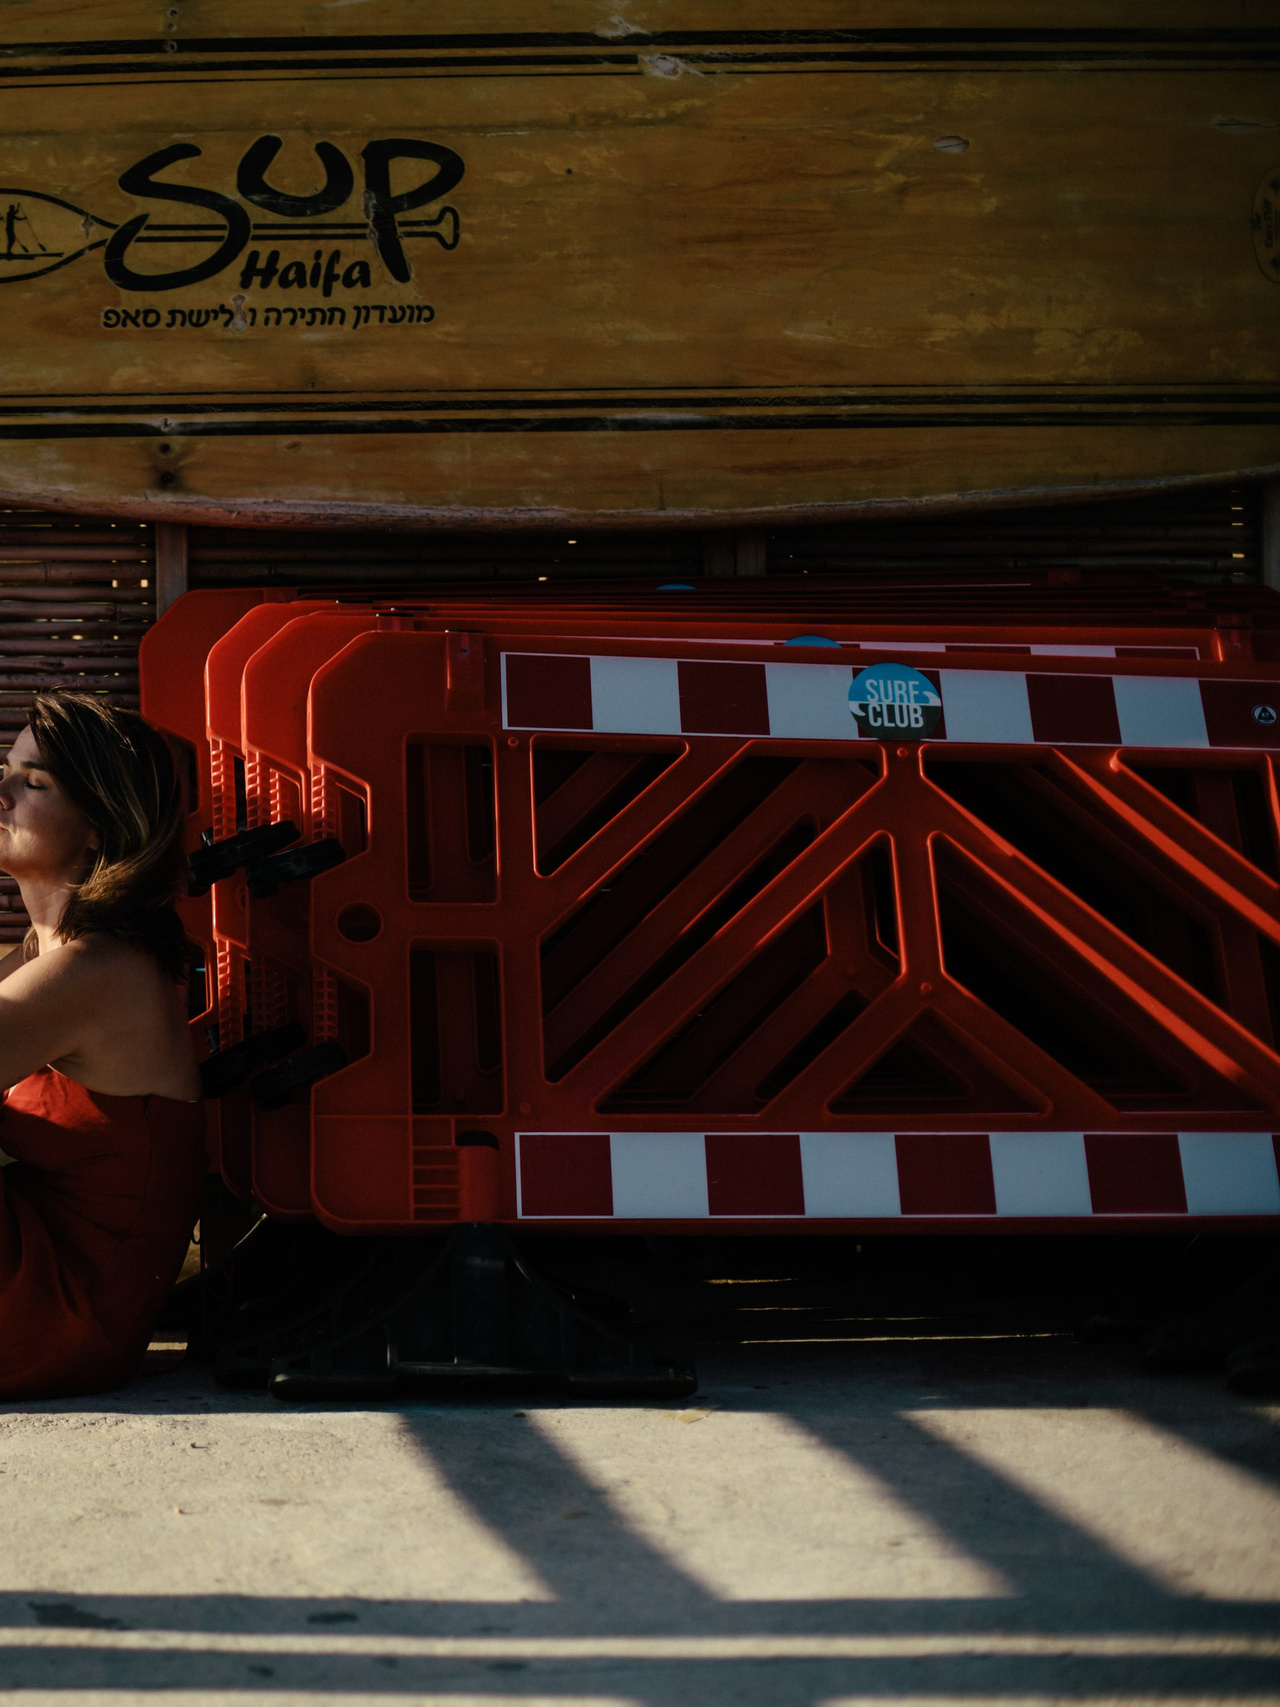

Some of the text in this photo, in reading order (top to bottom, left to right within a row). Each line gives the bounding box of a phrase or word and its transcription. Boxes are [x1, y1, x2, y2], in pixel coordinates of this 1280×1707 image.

[103, 134, 465, 292] SUP
[240, 249, 372, 297] Haifa
[102, 304, 436, 330] מועדון חתירה ולישת סאפ
[865, 679, 920, 704] SURF
[867, 702, 924, 728] CLUB
